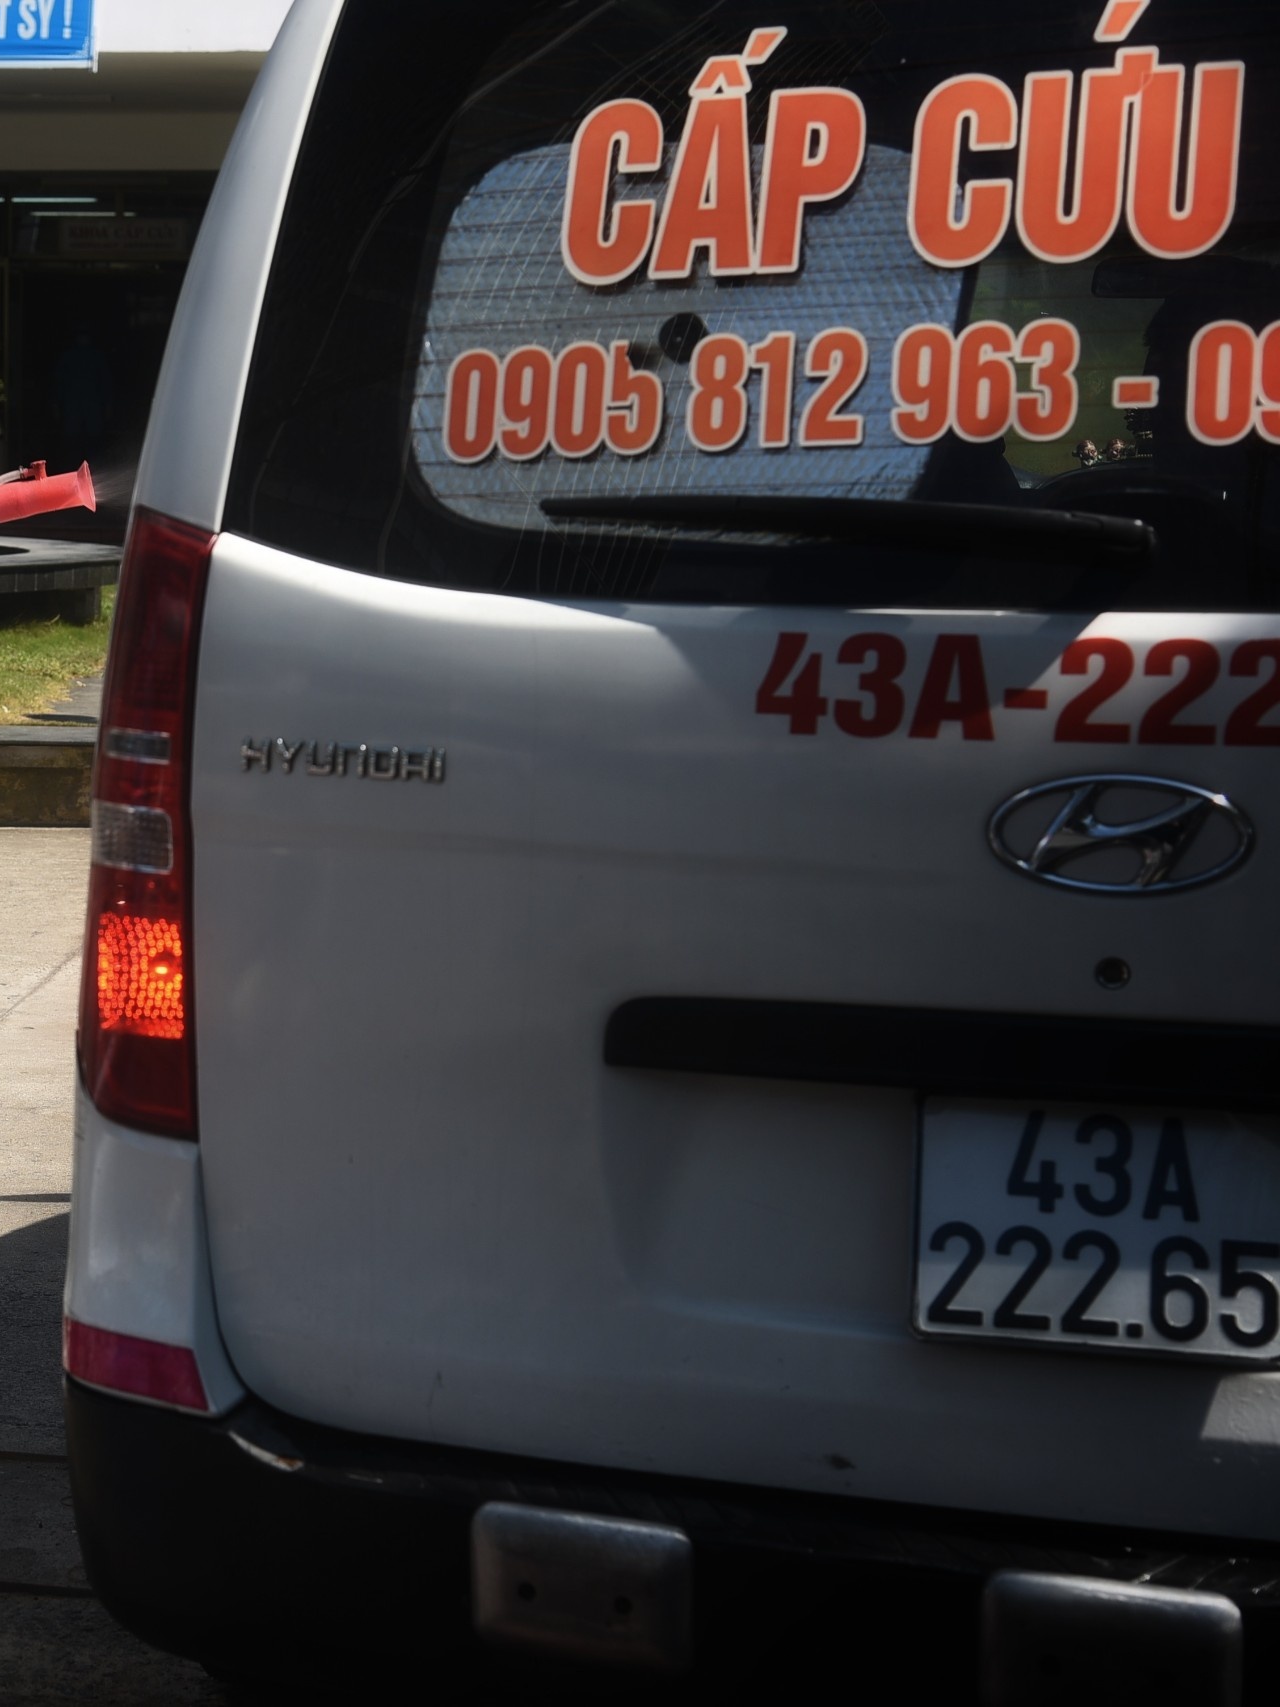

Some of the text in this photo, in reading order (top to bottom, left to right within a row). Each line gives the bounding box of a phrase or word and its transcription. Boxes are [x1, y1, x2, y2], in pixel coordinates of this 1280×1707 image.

[560, 0, 1245, 286] CẤP CỨU
[443, 339, 663, 463] 0905
[687, 328, 868, 452] 812
[891, 318, 1080, 443] 963
[755, 631, 1280, 747] 43A-222
[241, 736, 446, 784] HYUNDAI
[1006, 1109, 1200, 1222] 43A
[926, 1220, 1280, 1348] 222.65
